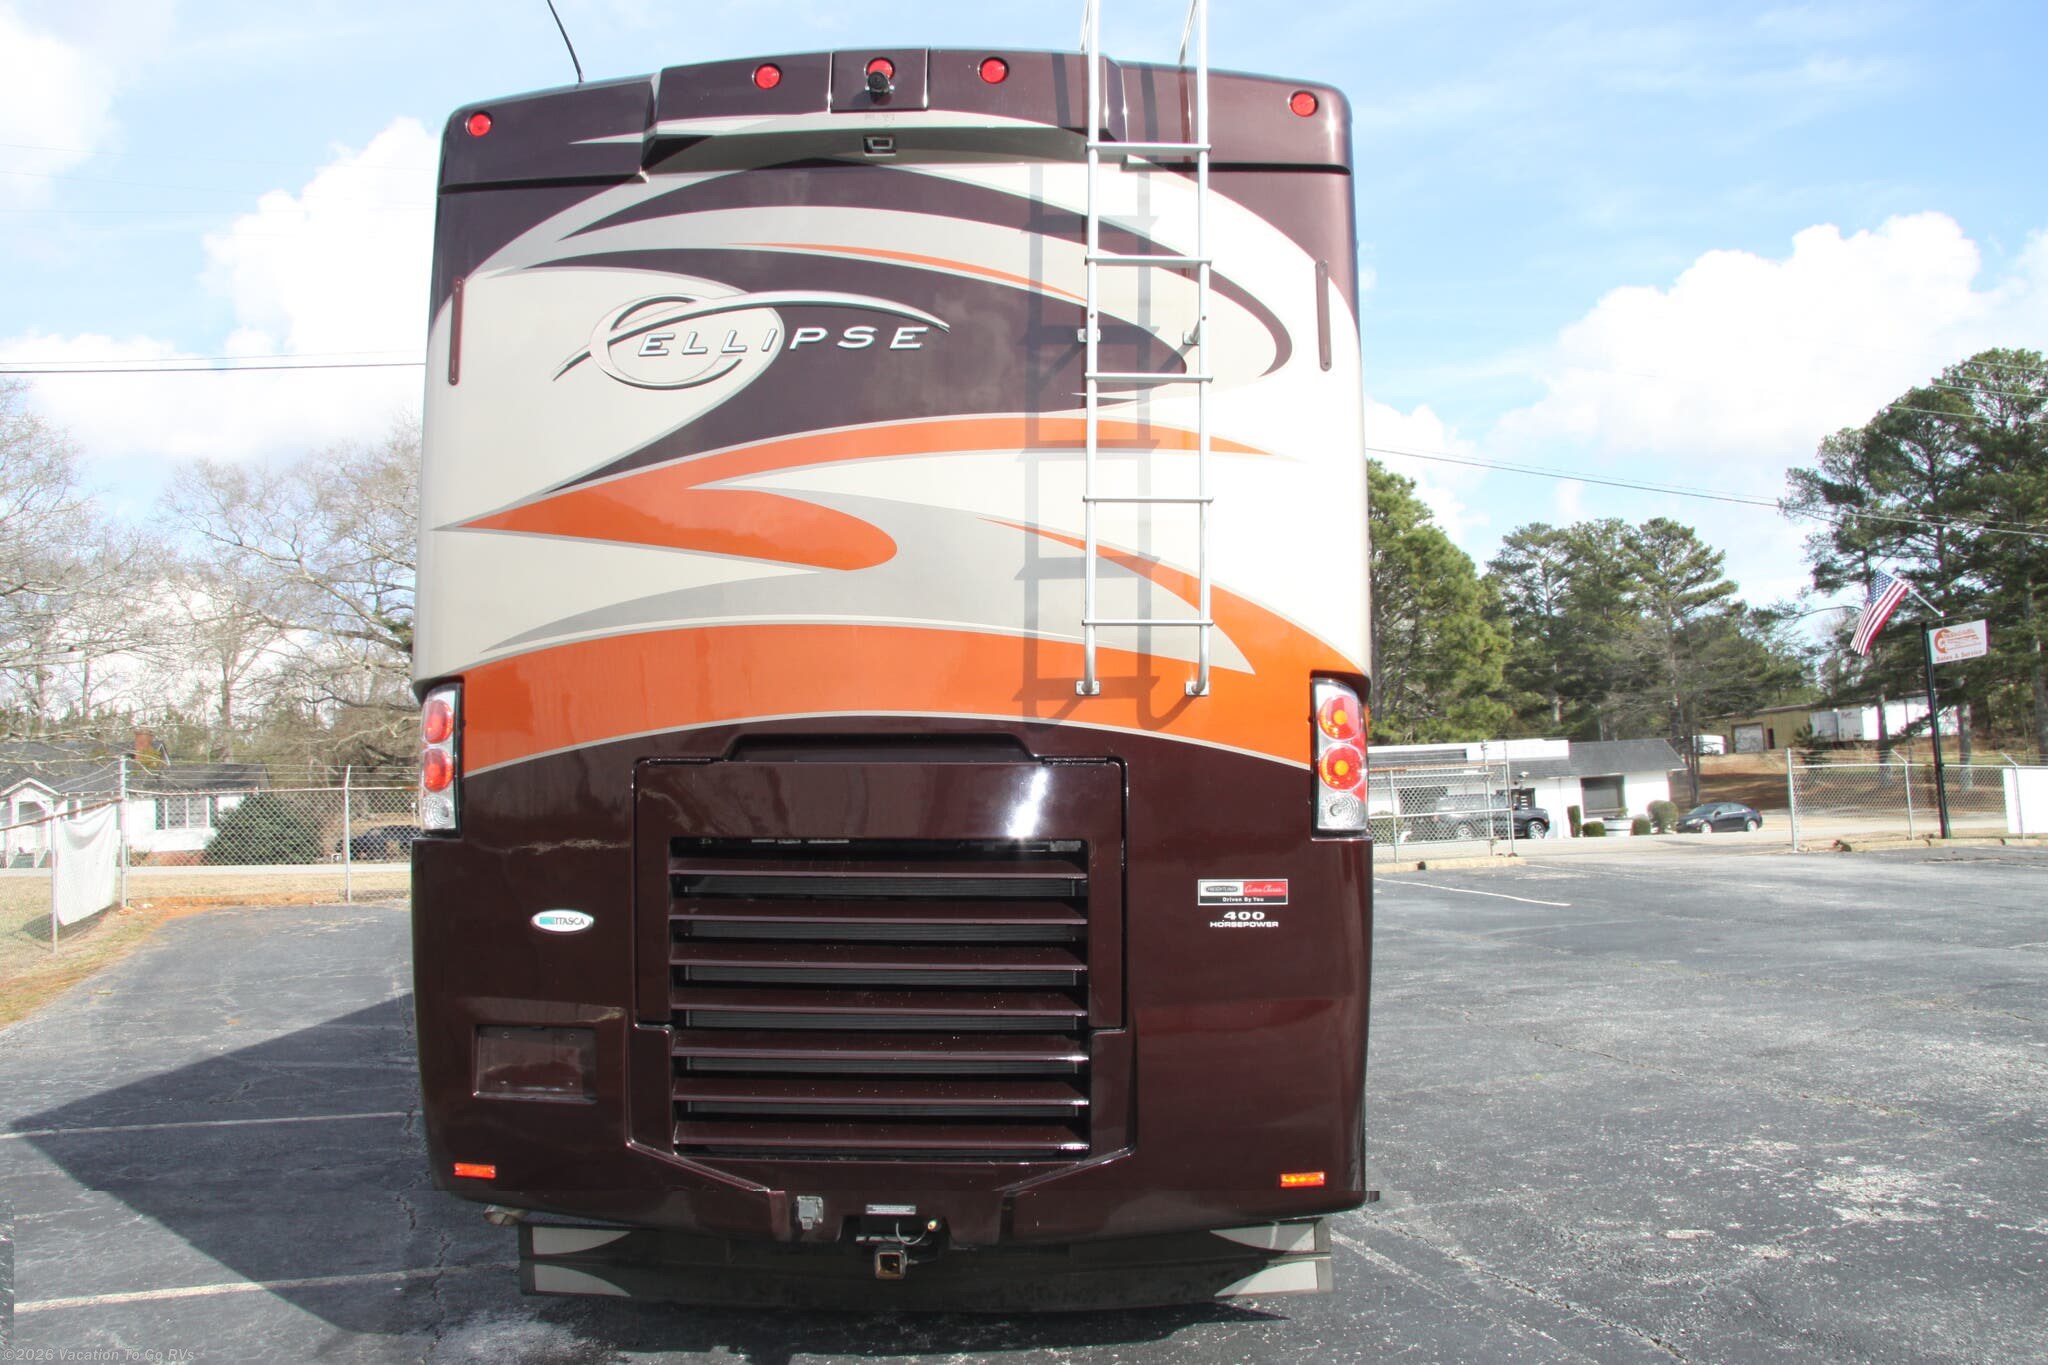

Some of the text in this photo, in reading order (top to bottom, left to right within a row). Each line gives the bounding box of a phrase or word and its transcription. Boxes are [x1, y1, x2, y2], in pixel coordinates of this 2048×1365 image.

[637, 326, 929, 357] ELLIPSE
[1223, 911, 1266, 921] 400
[555, 917, 585, 926] ITASCA
